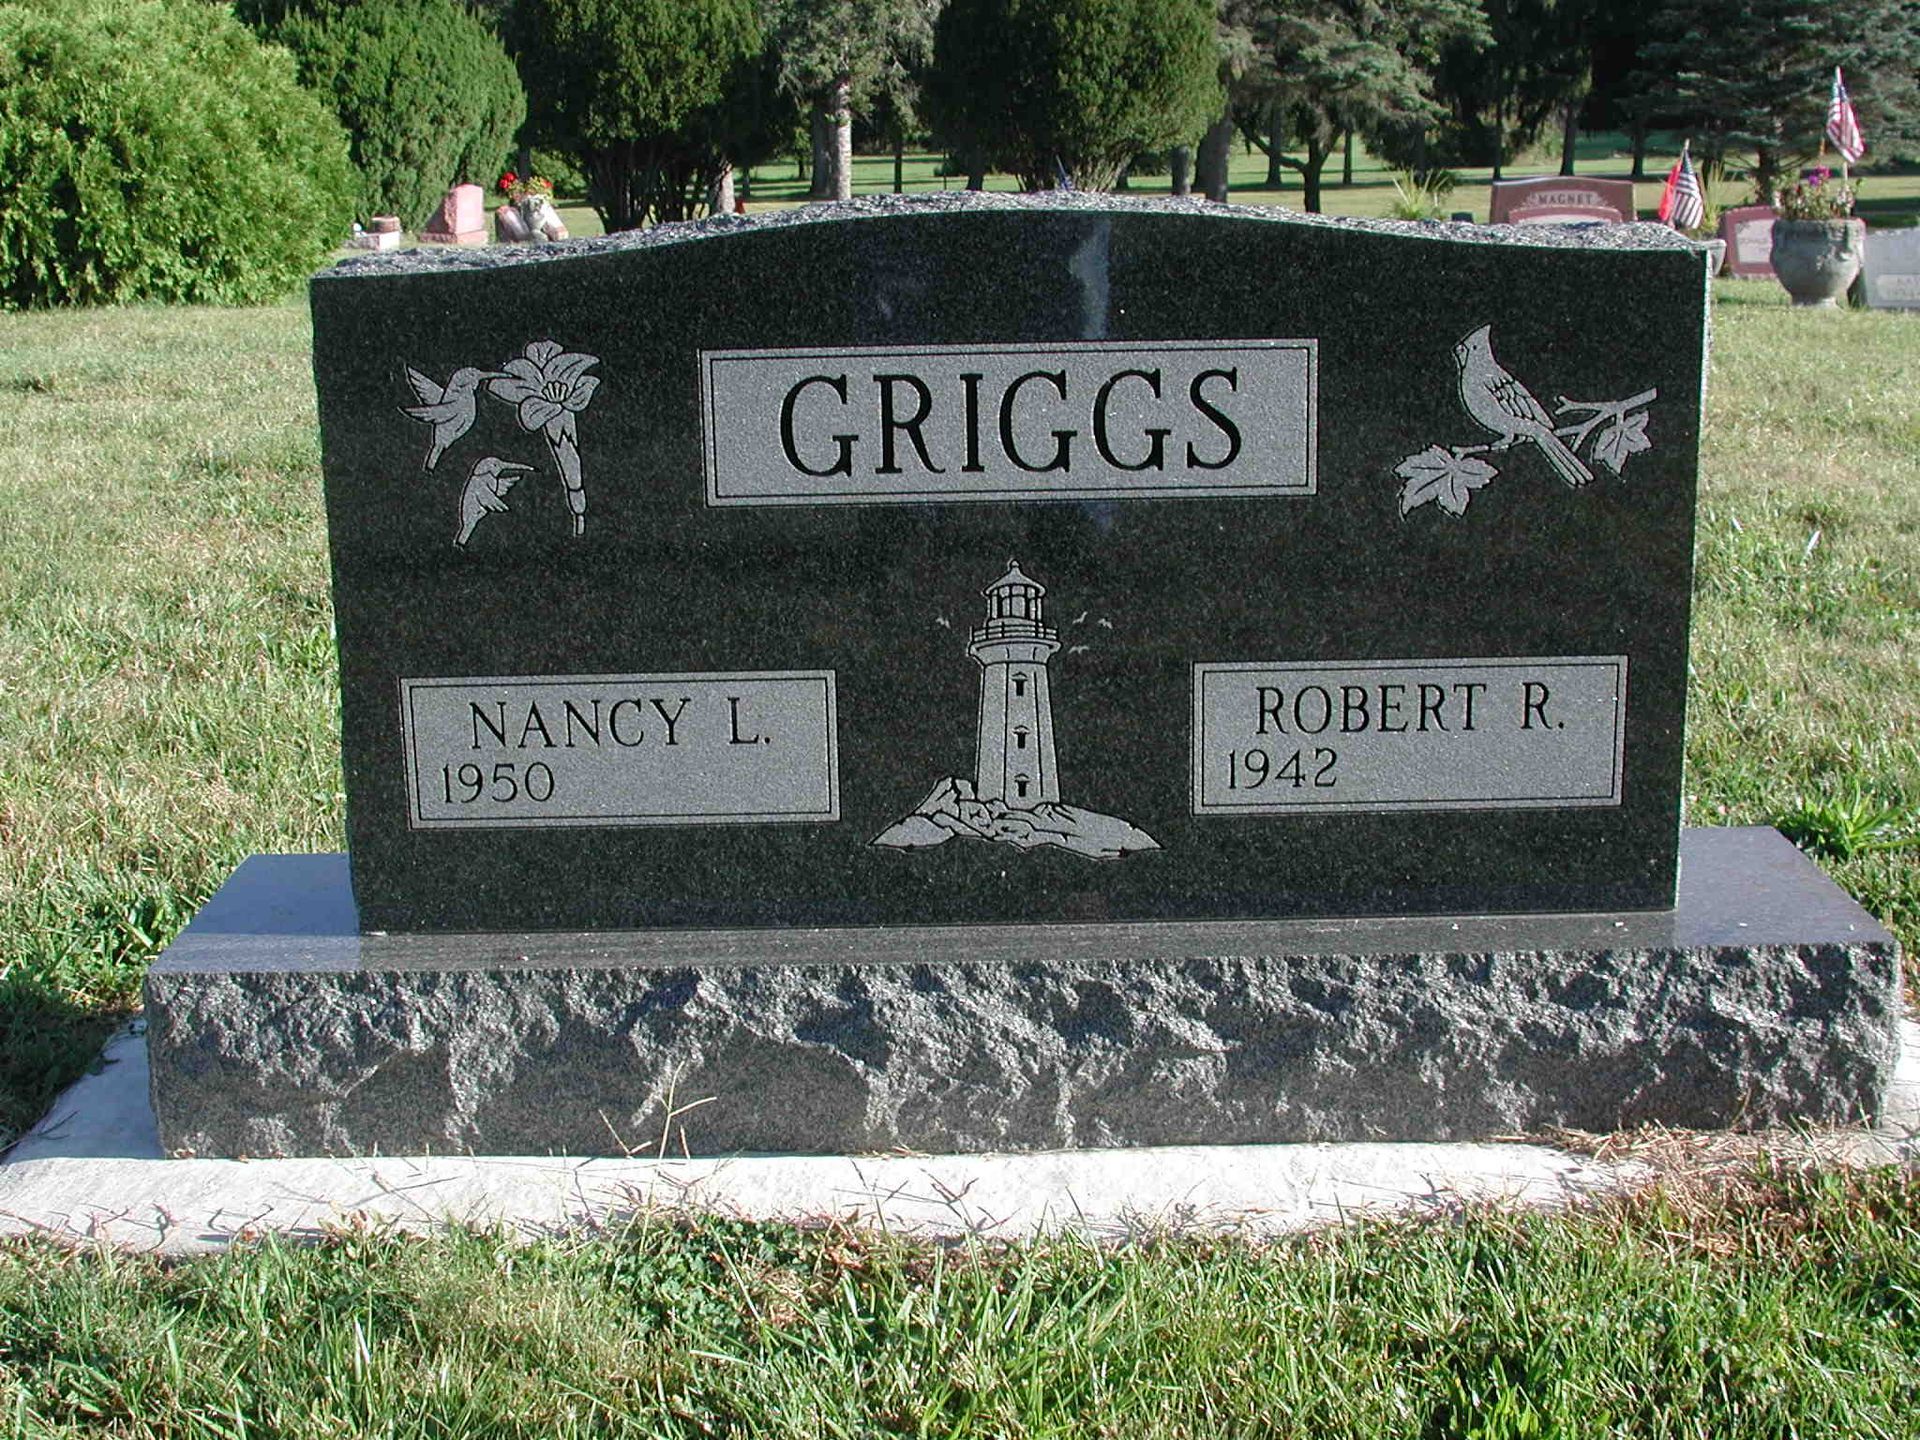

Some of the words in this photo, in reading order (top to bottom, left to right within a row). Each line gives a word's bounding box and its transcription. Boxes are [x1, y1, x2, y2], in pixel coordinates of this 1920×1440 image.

[1538, 193, 1594, 205] MAGNET
[779, 366, 1243, 478] GRIGGS
[468, 697, 691, 750] NANCY
[726, 696, 772, 745] L.
[1255, 683, 1487, 735] ROBERT
[1521, 681, 1565, 730] R.
[441, 761, 556, 804] 1950
[1228, 746, 1338, 790] 1942
